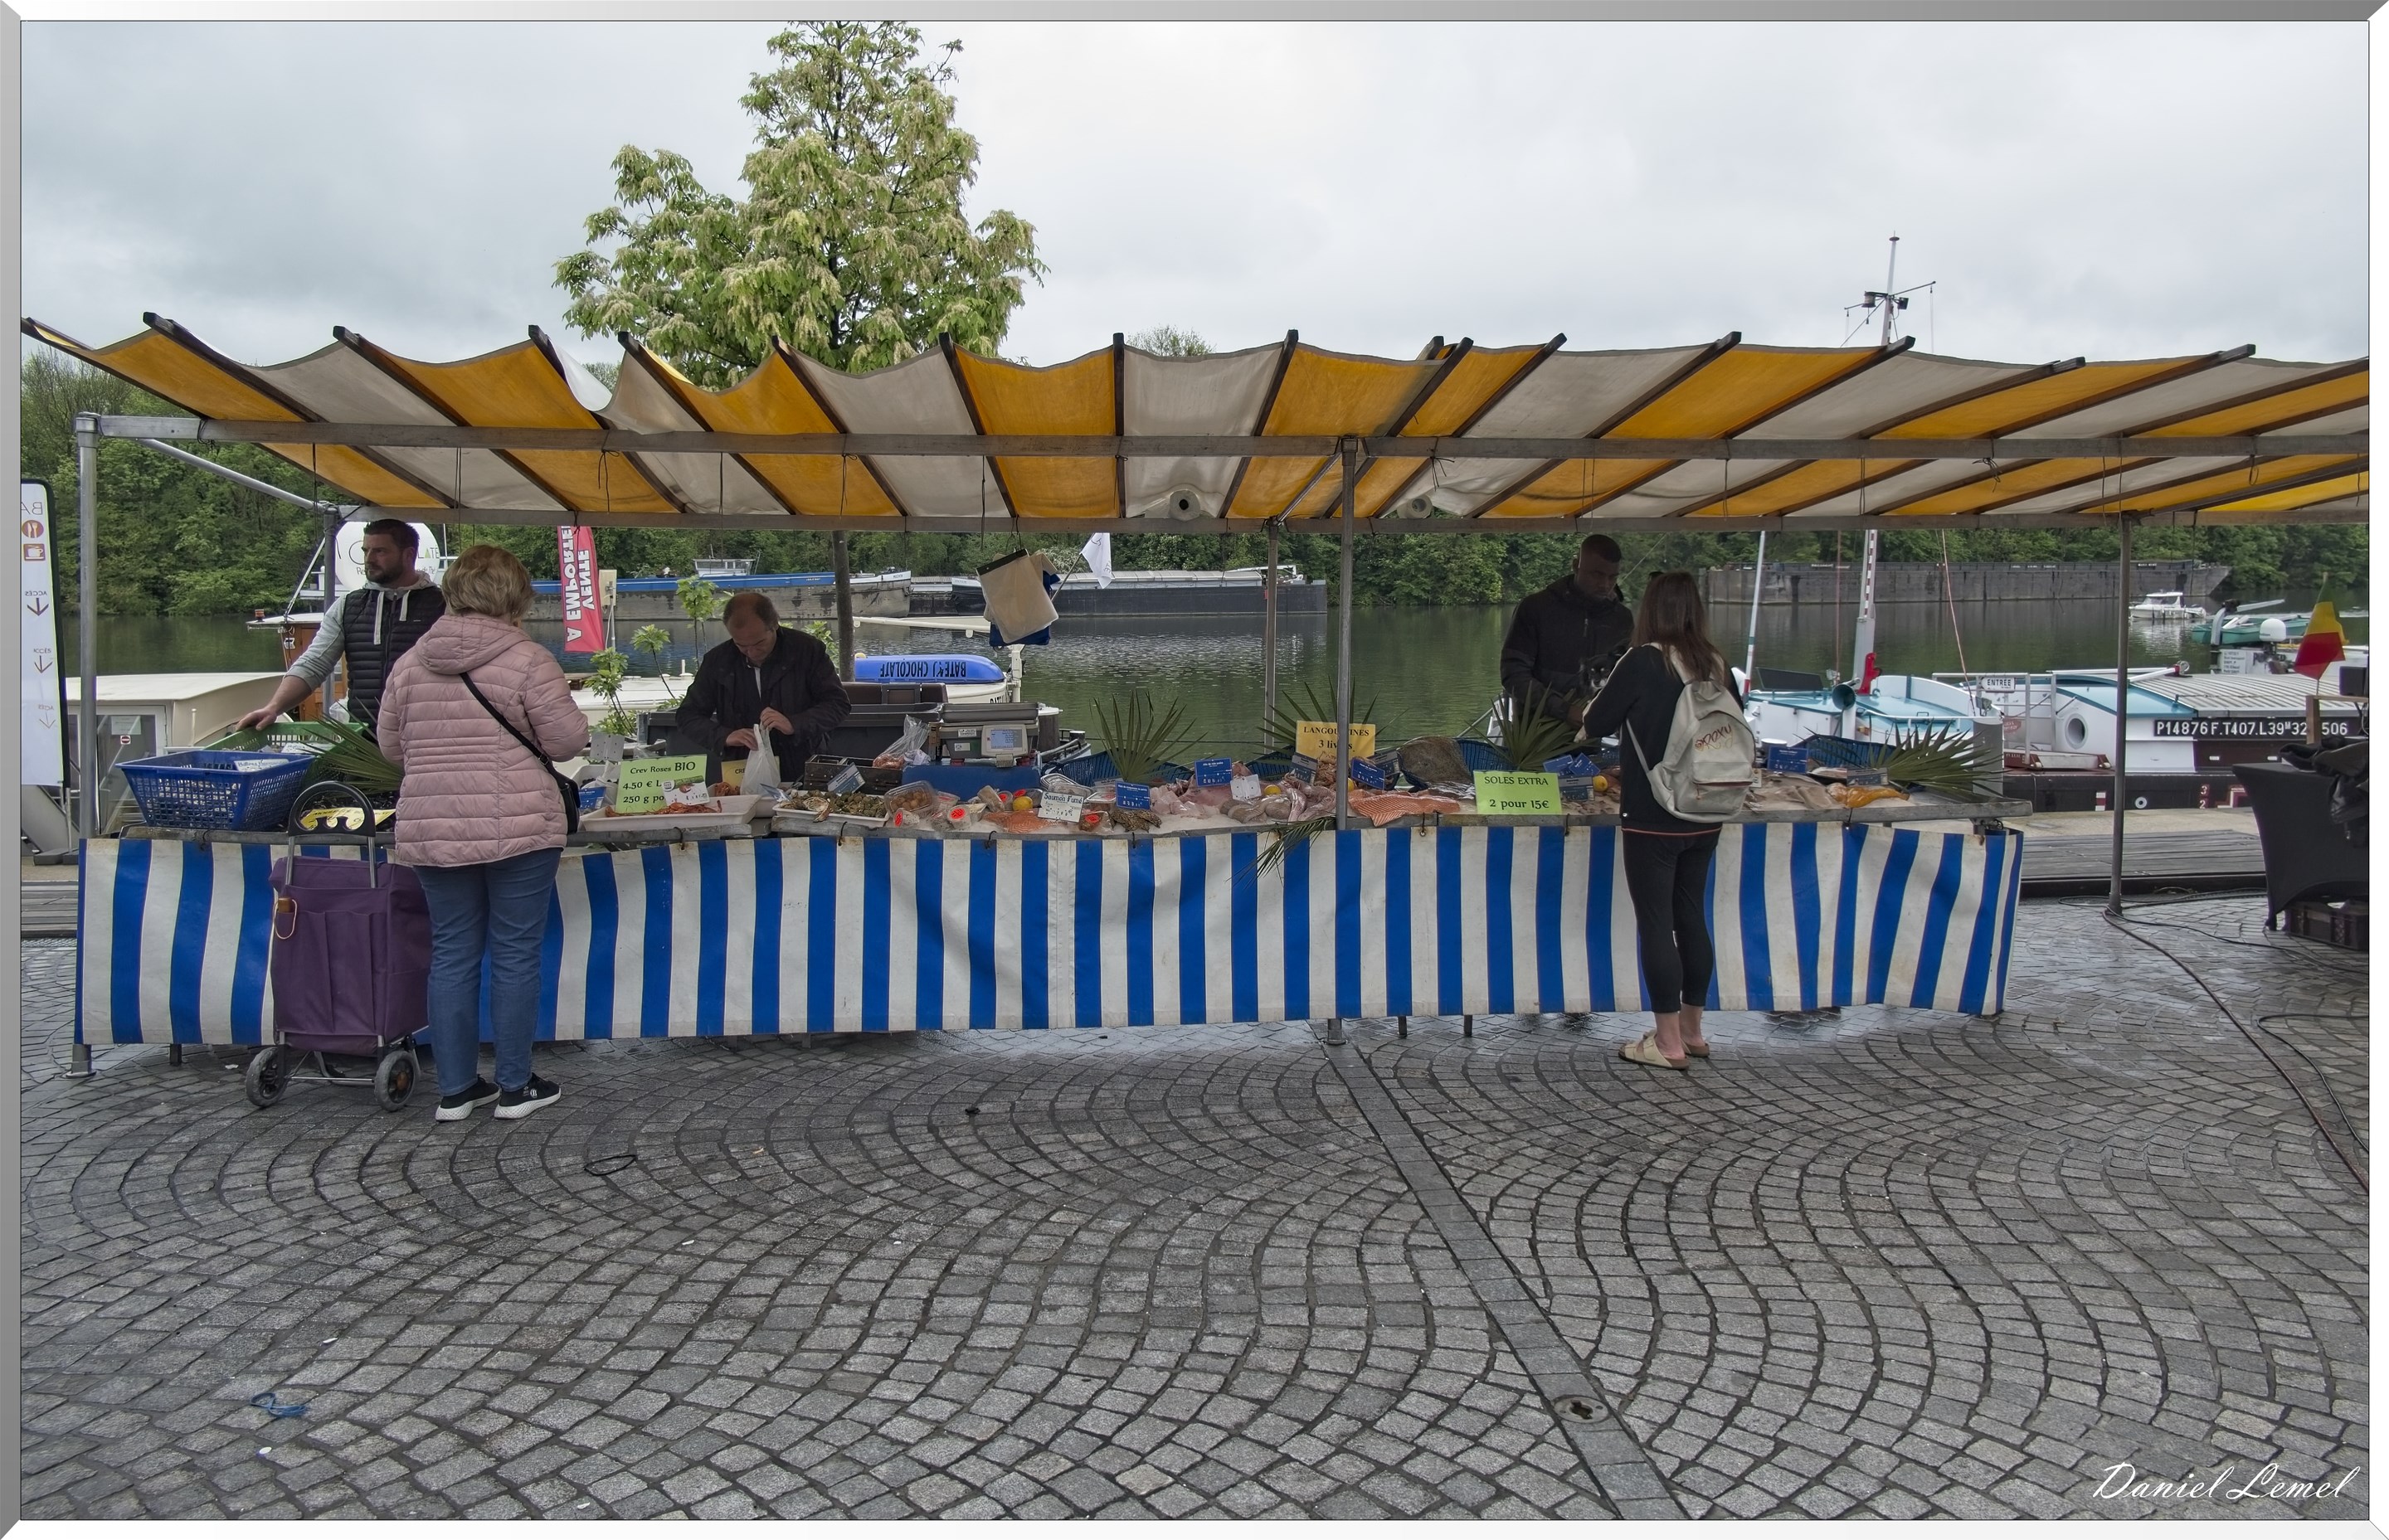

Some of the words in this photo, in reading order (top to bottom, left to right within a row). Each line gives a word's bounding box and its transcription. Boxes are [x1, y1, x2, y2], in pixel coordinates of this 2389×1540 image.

[1303, 726, 1370, 736] LANGOINES
[1318, 739, 1324, 748] 3
[1327, 740, 1353, 749] livs
[674, 761, 696, 771] BIO
[622, 781, 643, 790] 4.50
[1484, 776, 1515, 785] SOLES
[1518, 777, 1549, 785] EXTRA
[623, 795, 640, 804] 250
[643, 796, 650, 804] g
[653, 795, 664, 804] po
[1044, 792, 1066, 802] Saumon
[1068, 795, 1083, 804] Fumé
[1489, 799, 1496, 808] 2
[1501, 801, 1527, 810] pour
[1530, 799, 1550, 809] 15€
